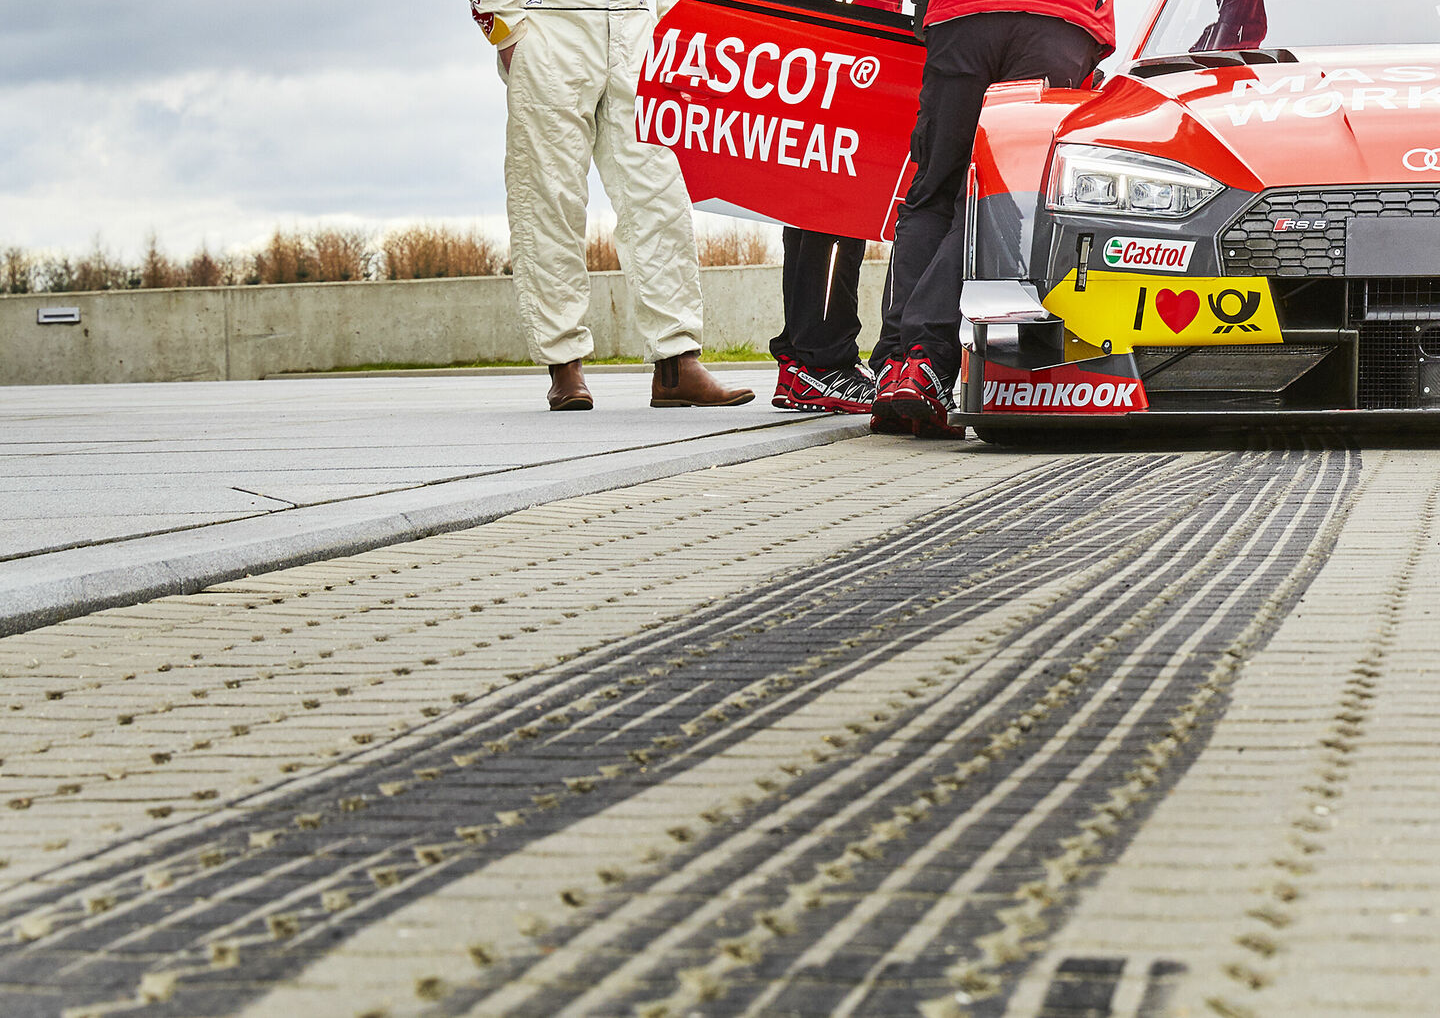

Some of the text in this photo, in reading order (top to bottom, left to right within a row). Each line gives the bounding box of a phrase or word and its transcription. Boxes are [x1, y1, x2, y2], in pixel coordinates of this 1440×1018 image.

[635, 94, 860, 177] WORKWEAR
[1122, 240, 1188, 267] Castrol
[1133, 286, 1147, 331] I
